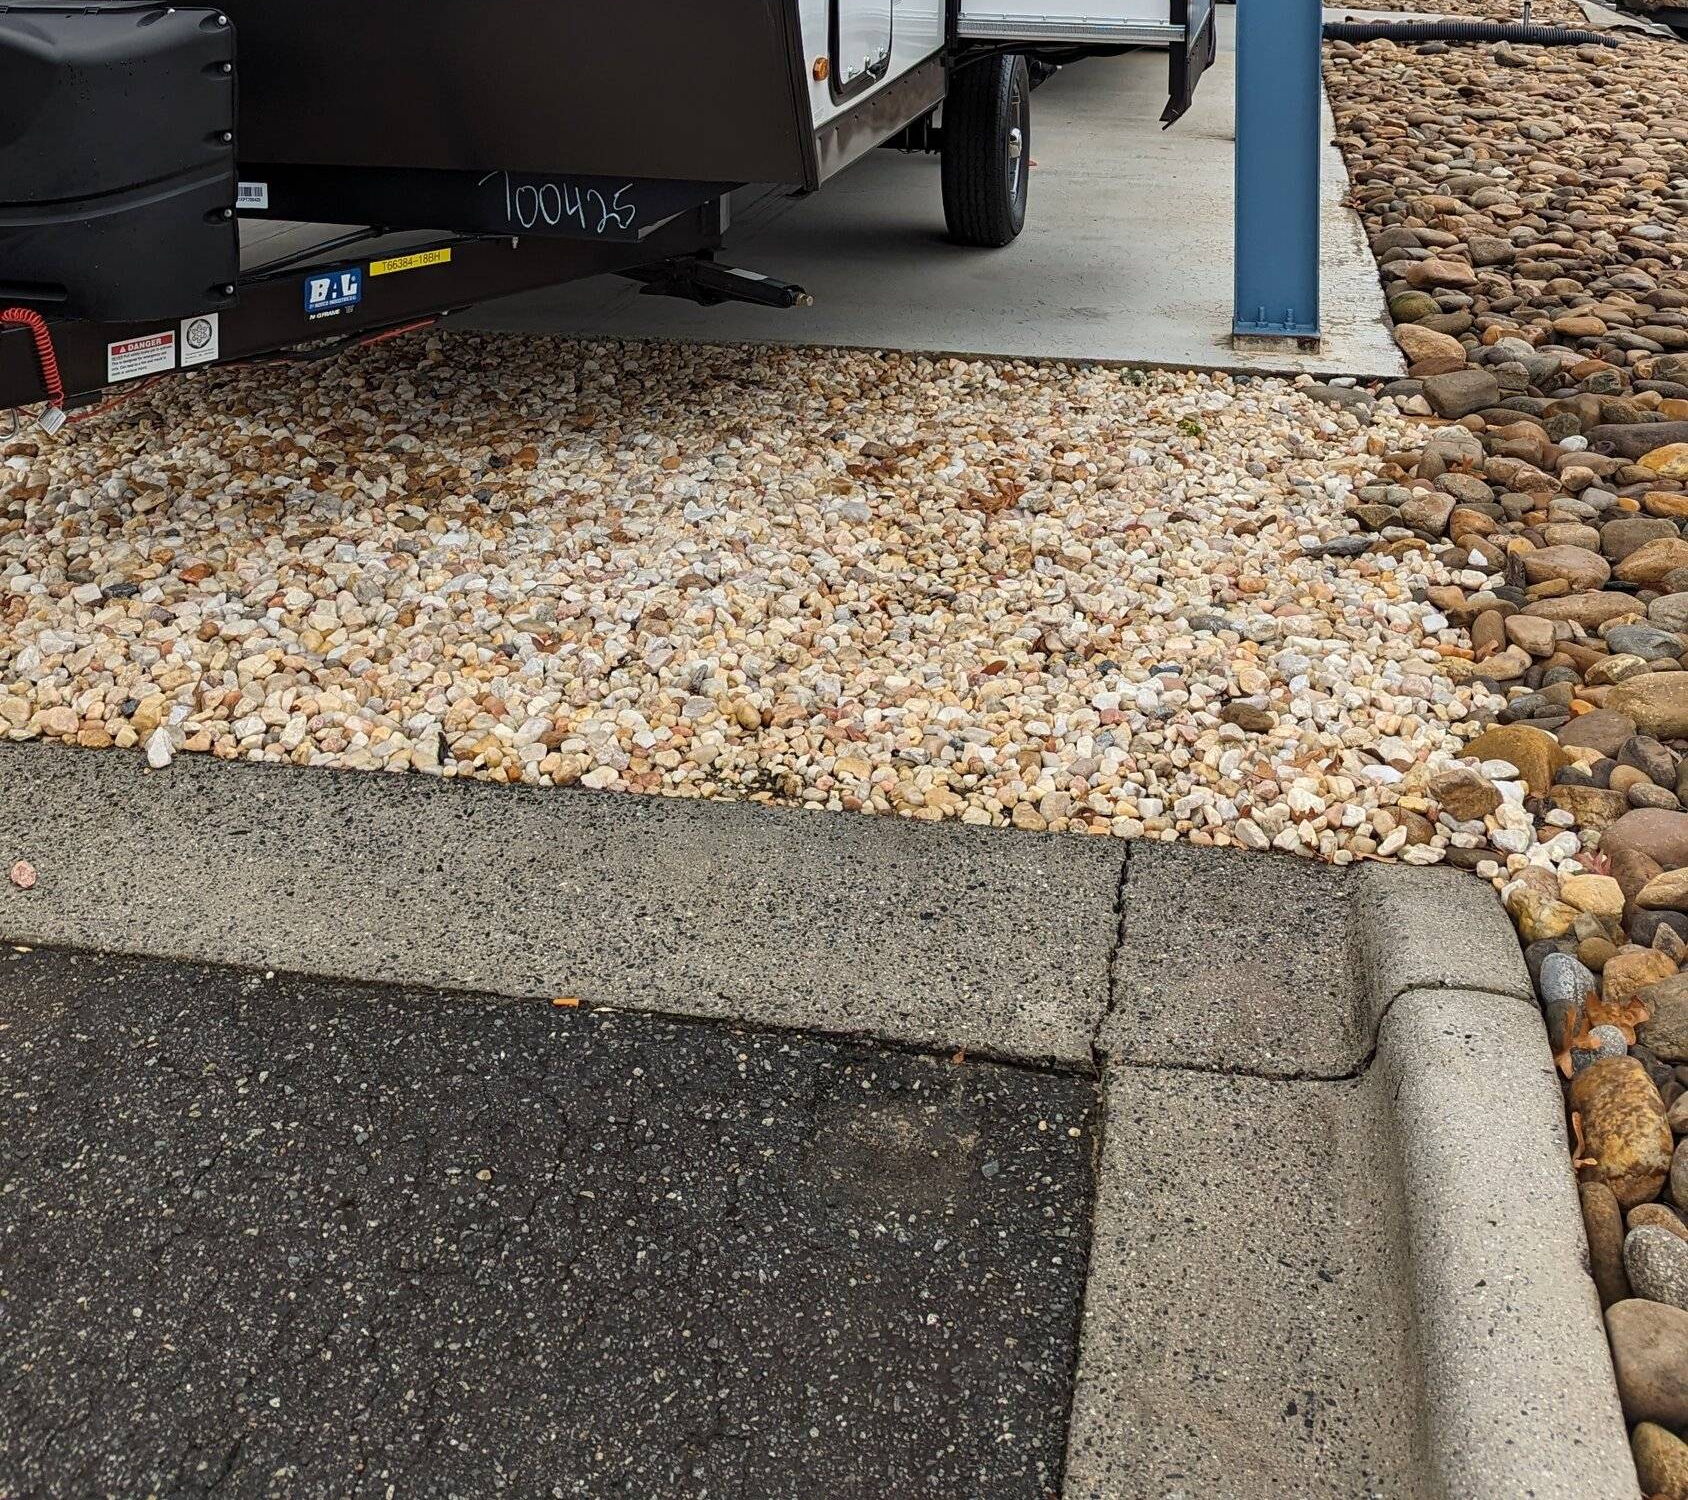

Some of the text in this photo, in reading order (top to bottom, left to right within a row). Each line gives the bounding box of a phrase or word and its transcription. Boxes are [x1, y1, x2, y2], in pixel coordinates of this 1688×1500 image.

[478, 170, 636, 233] 700425
[383, 252, 441, 272] T66384-18BH
[310, 274, 358, 303] BAL
[127, 338, 162, 352] DANGER
